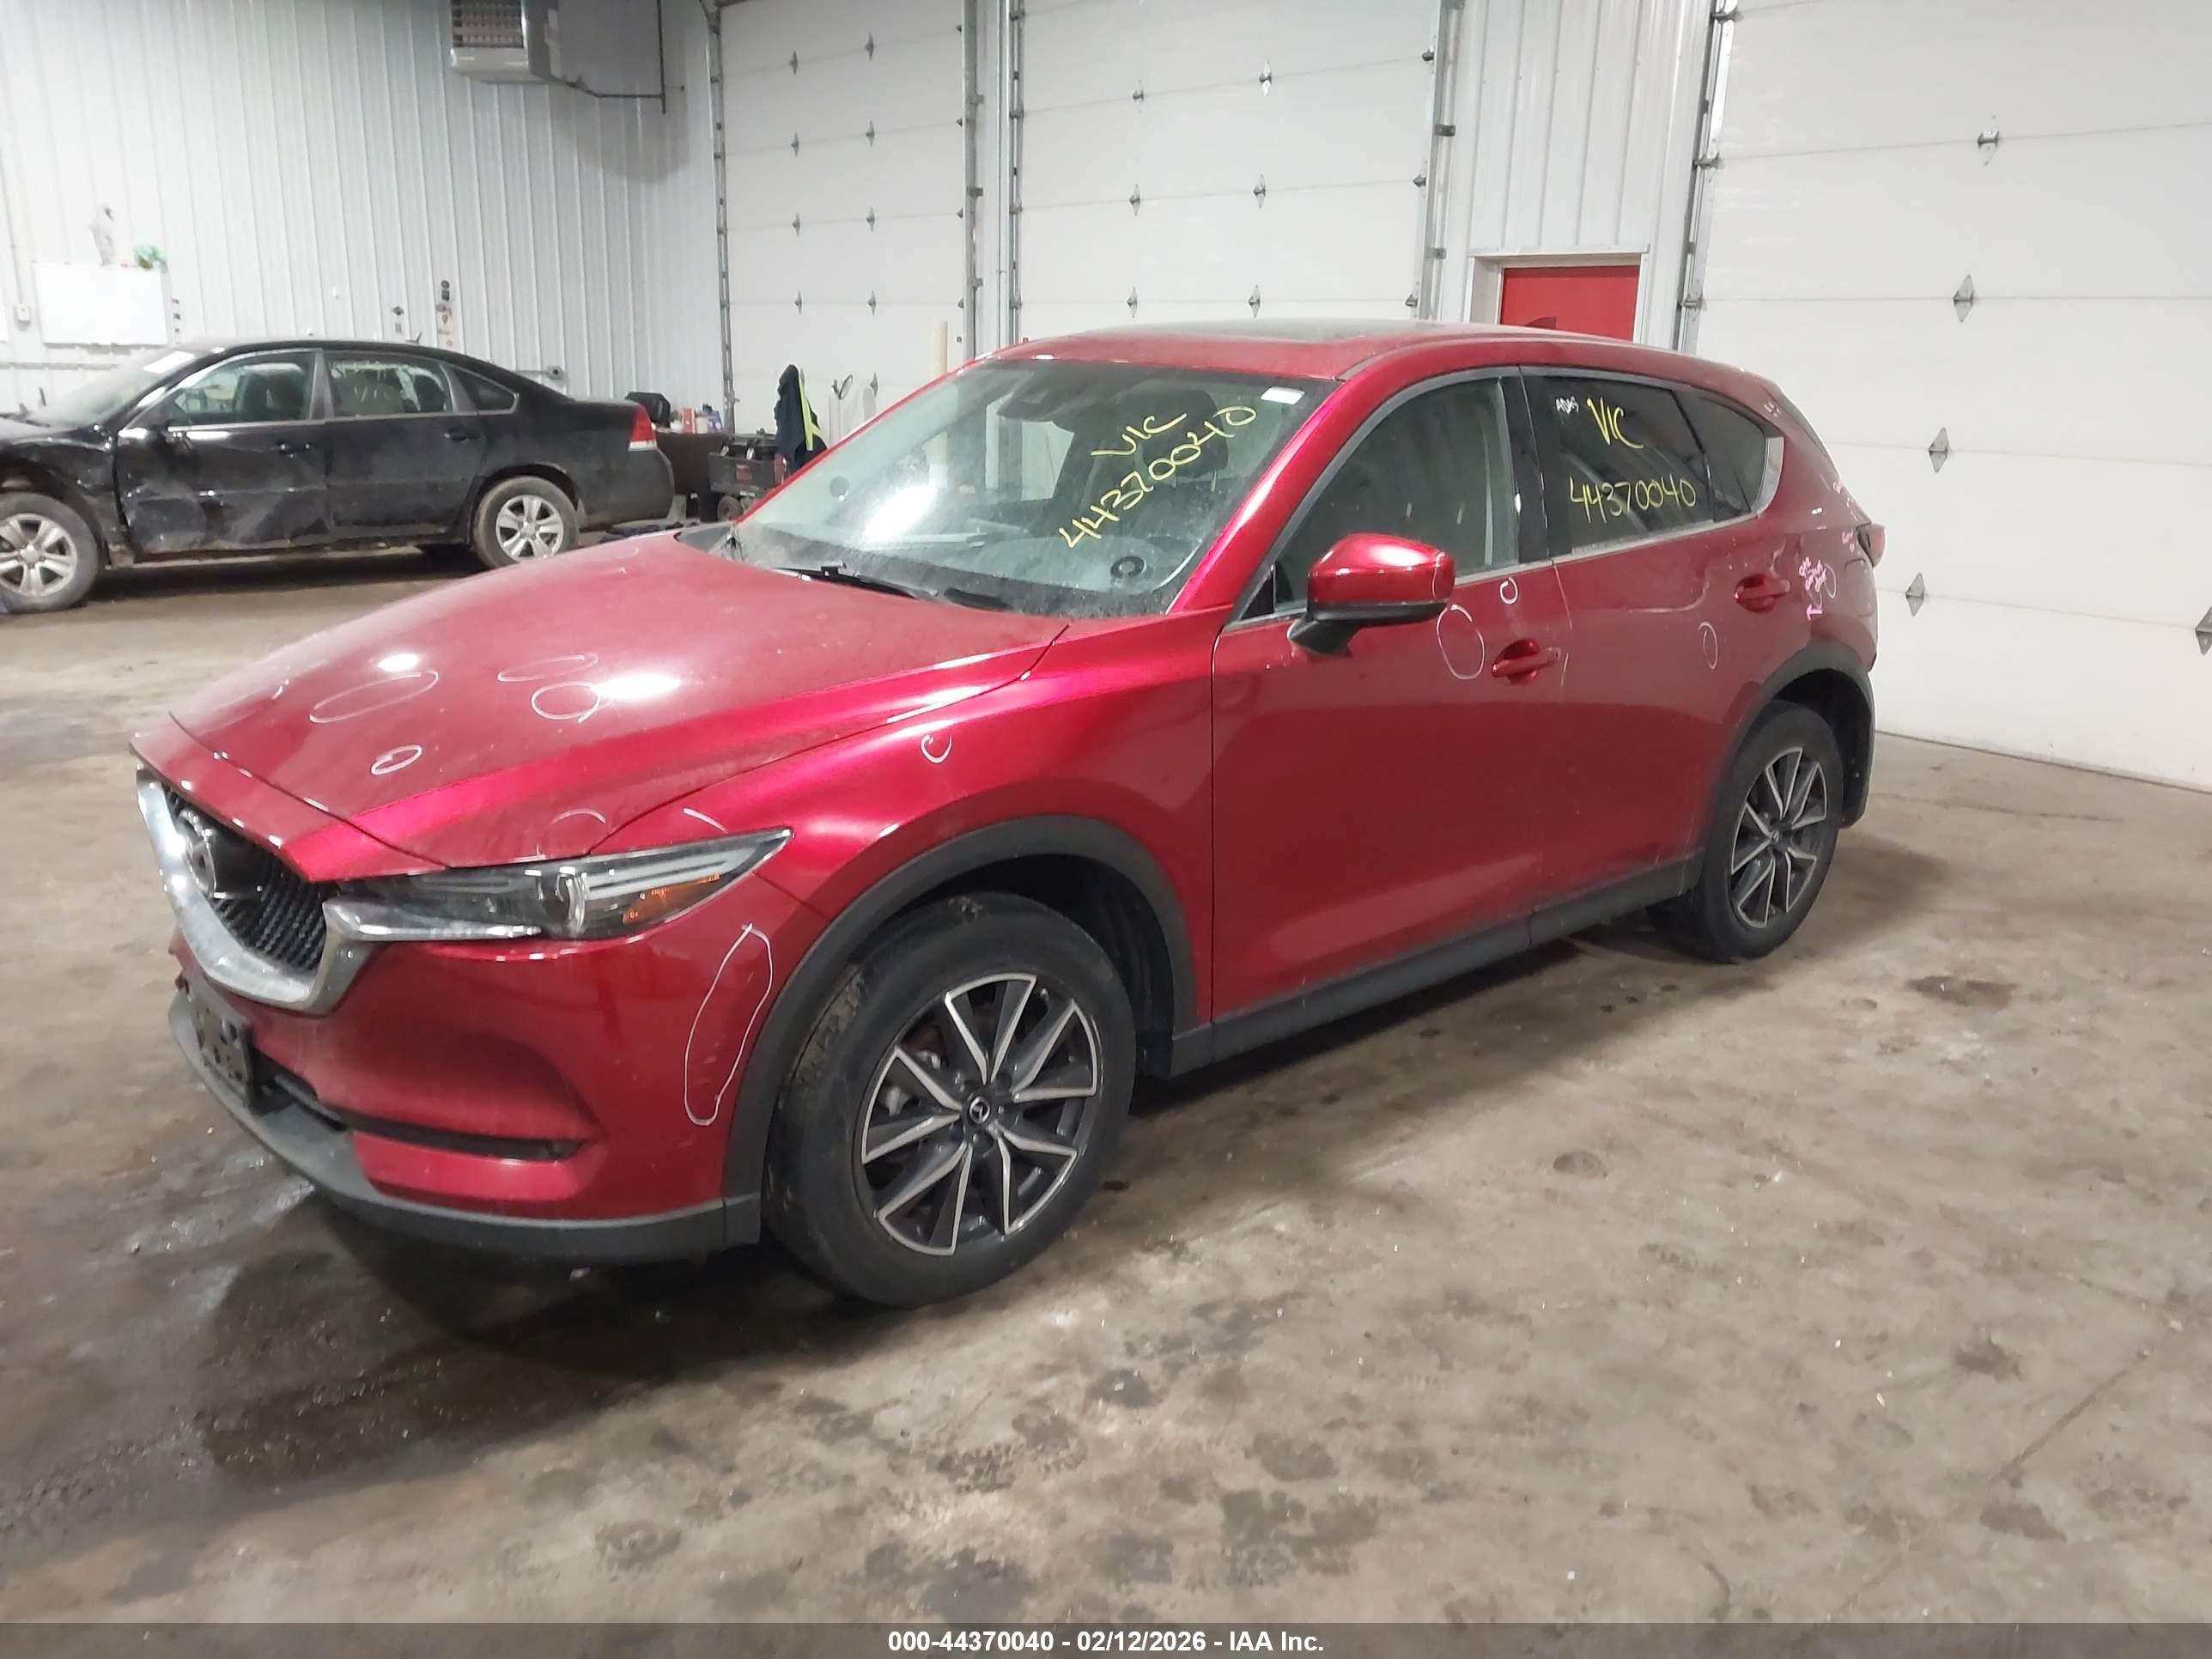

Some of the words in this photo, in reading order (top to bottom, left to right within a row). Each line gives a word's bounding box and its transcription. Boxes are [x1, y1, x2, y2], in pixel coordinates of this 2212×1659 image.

[1091, 413, 1188, 457] VIC
[1586, 397, 1644, 449] VIC
[1058, 405, 1258, 550] 44370040
[1569, 473, 1698, 525] 44370040
